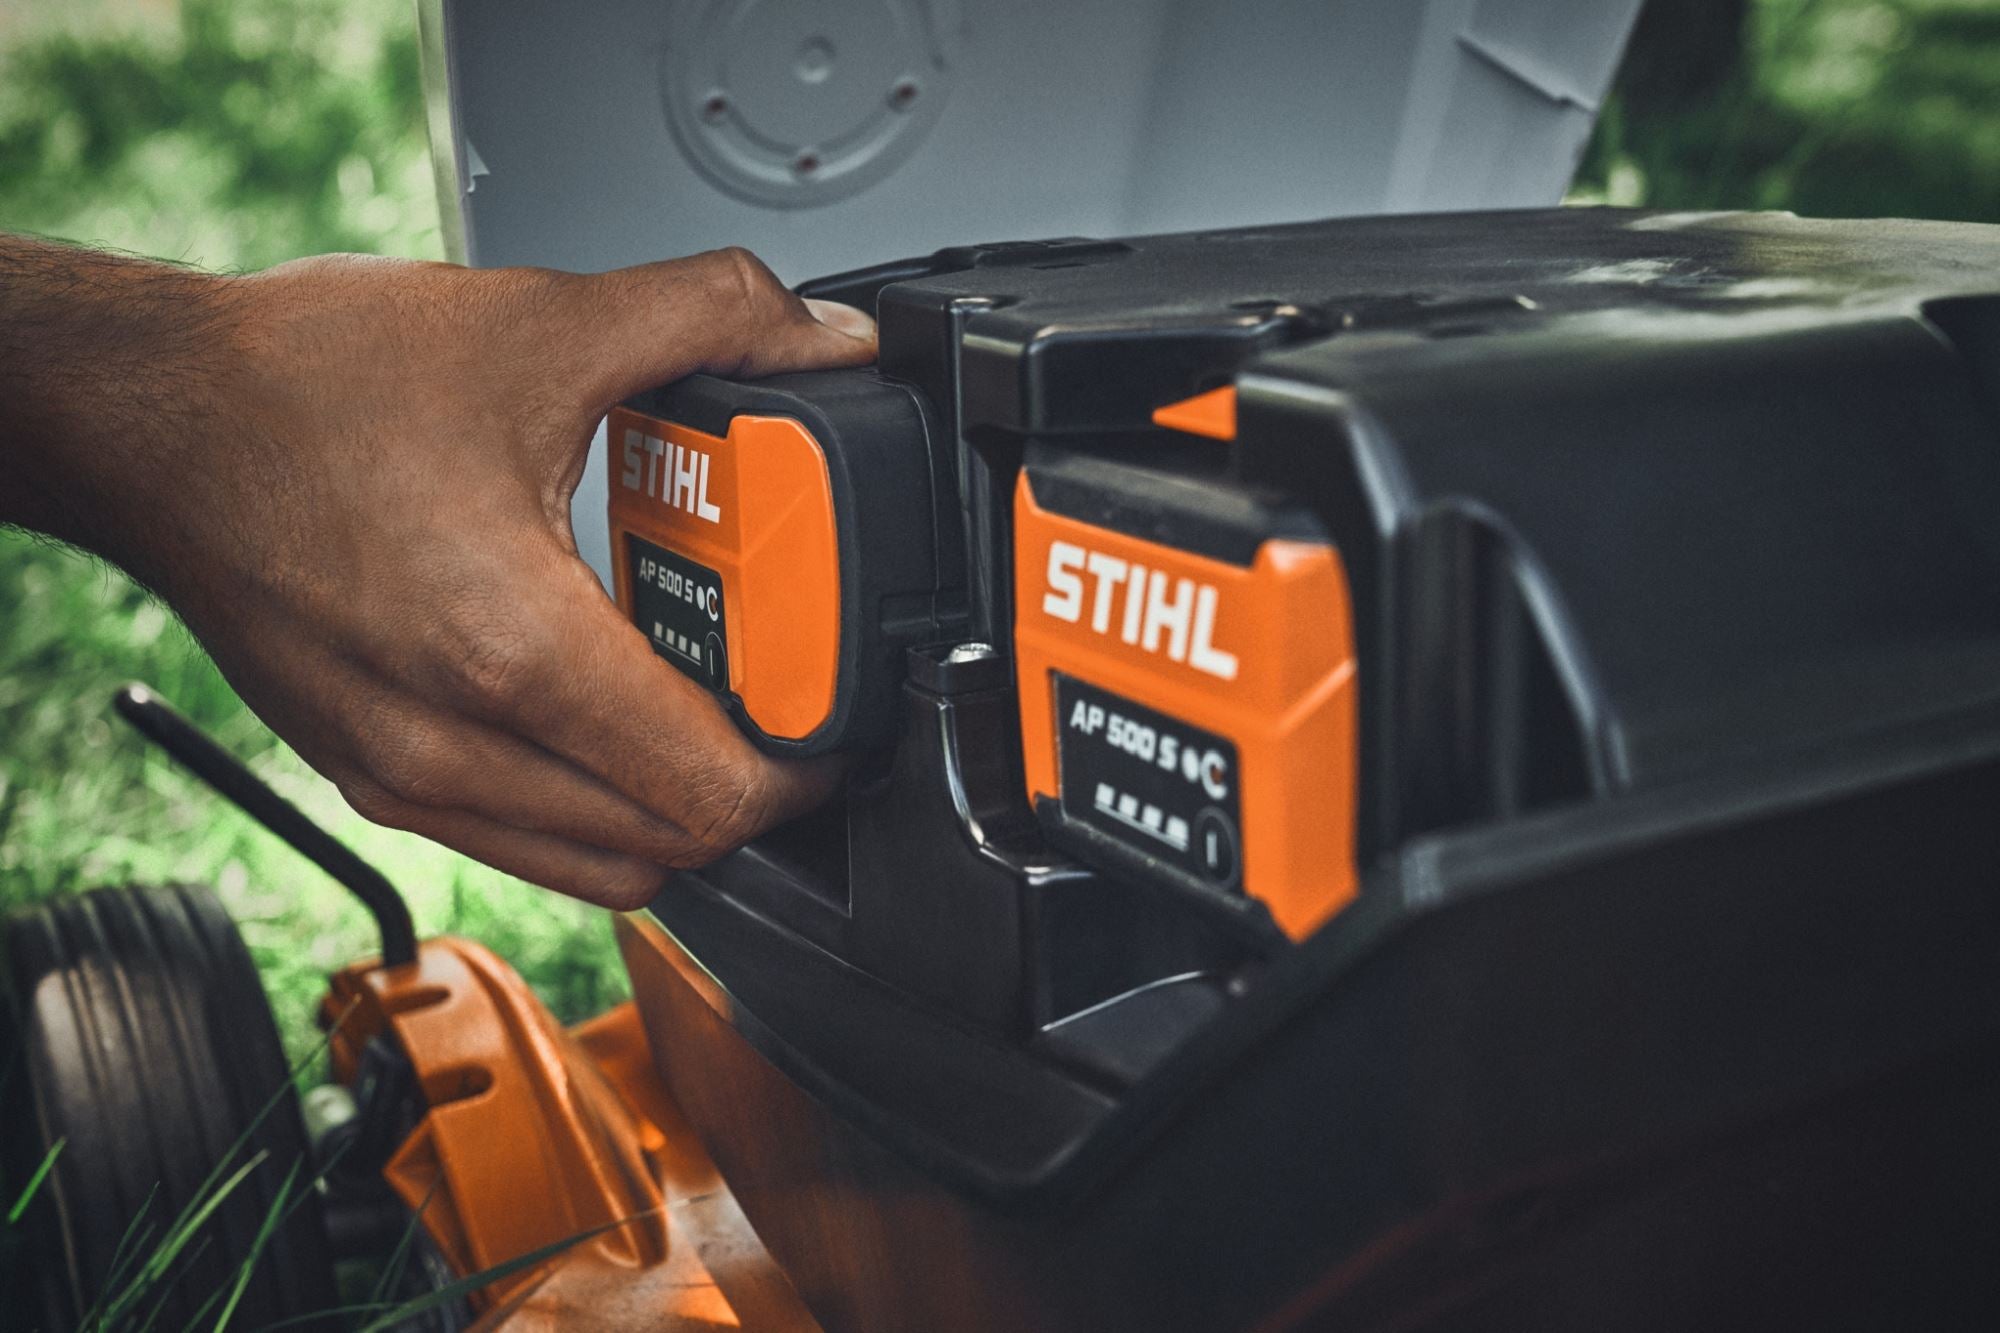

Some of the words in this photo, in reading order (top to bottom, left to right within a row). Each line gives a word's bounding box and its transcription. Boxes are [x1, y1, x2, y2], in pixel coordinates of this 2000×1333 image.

[622, 429, 720, 523] STIHL
[639, 557, 655, 583] AP
[658, 566, 682, 597] 500
[1043, 541, 1238, 680] STIHL
[1070, 700, 1103, 735] AP
[1106, 714, 1156, 762] 500
